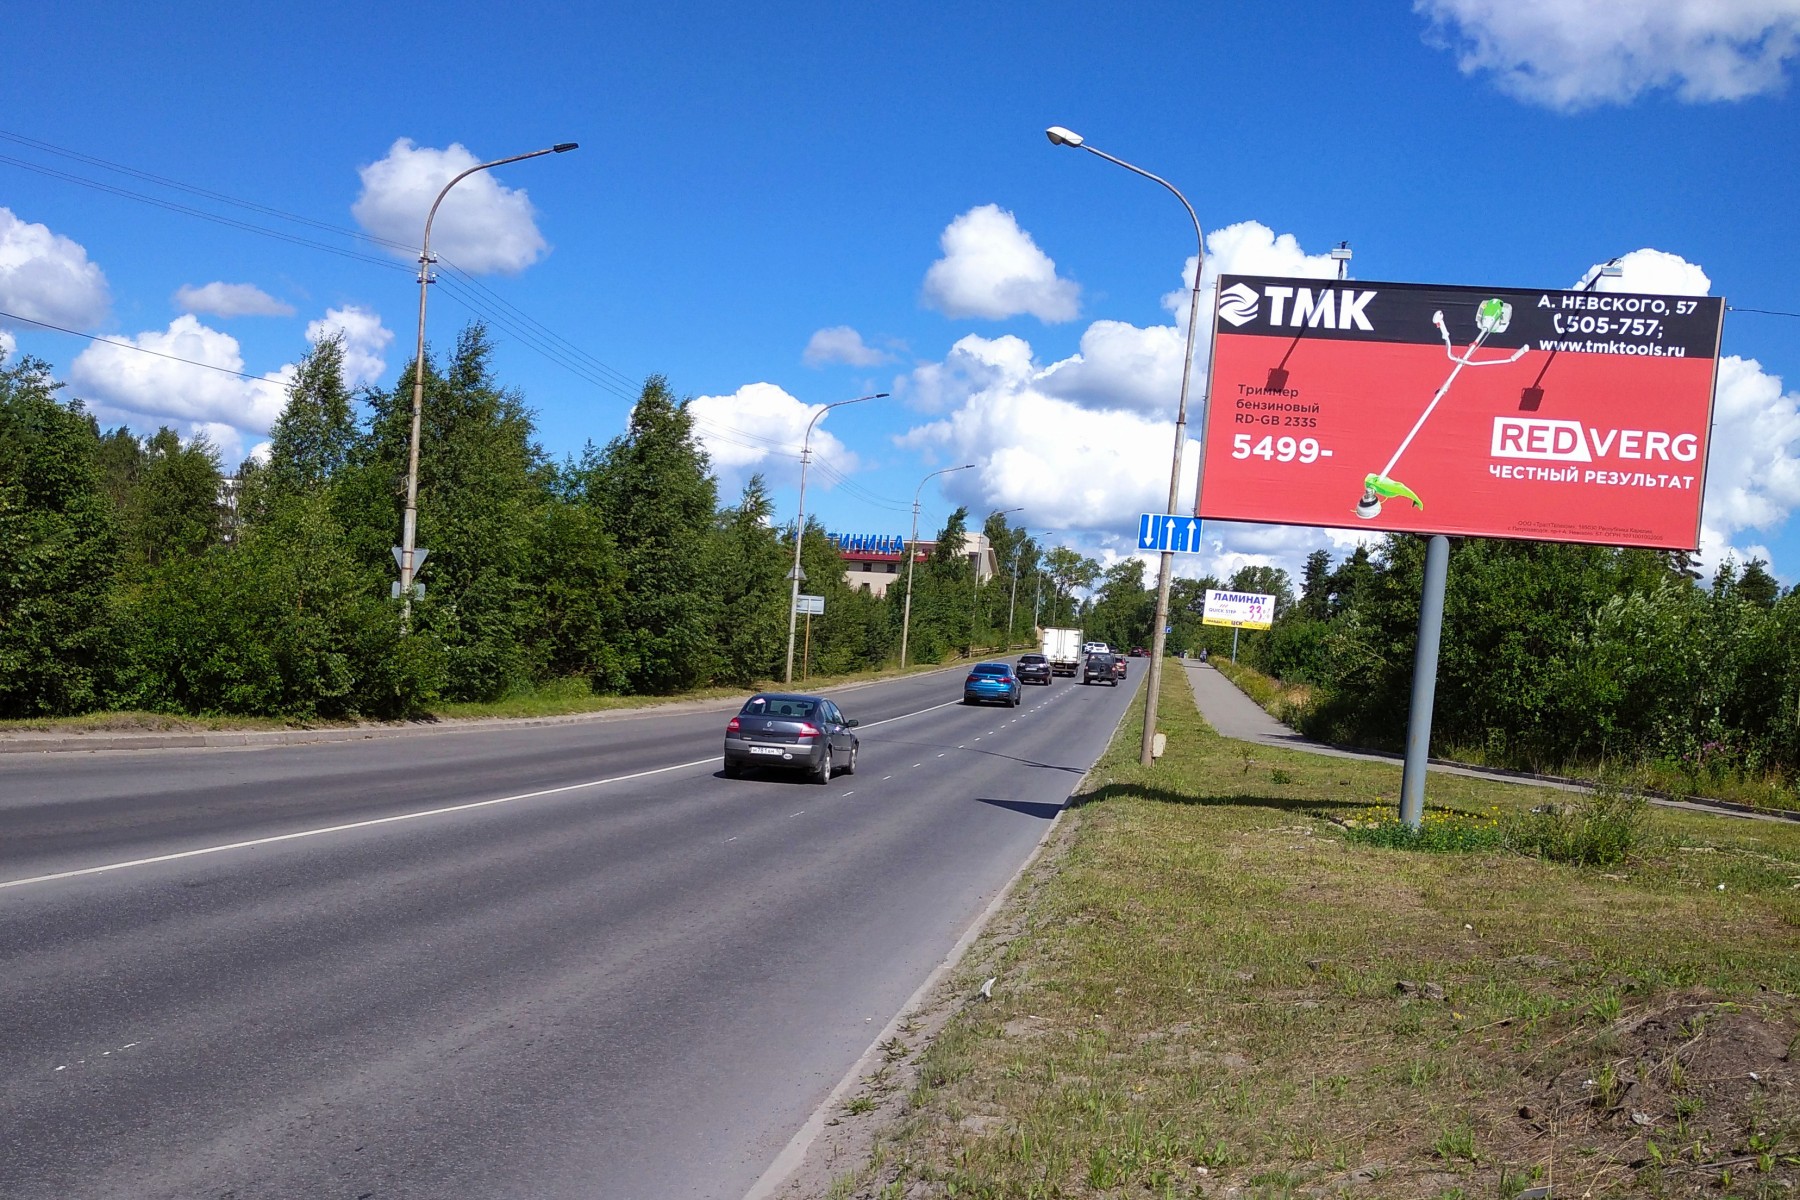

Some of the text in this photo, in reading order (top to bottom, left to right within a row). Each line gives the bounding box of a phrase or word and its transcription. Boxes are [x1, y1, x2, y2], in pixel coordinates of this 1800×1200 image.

[1264, 286, 1378, 331] ТМК
[1537, 294, 1698, 316] А. НЕВСКОГО, 57
[1539, 339, 1686, 358] www.tmktools.ru
[1237, 384, 1299, 399] Триммер
[1236, 398, 1320, 413] бензиновый
[1235, 413, 1317, 428] RD-GB 233S
[1488, 464, 1695, 490] ЧЕСТНЫЙ РЕЗУЛЬТАТ
[1213, 593, 1267, 605] ЛАМИНАТ
